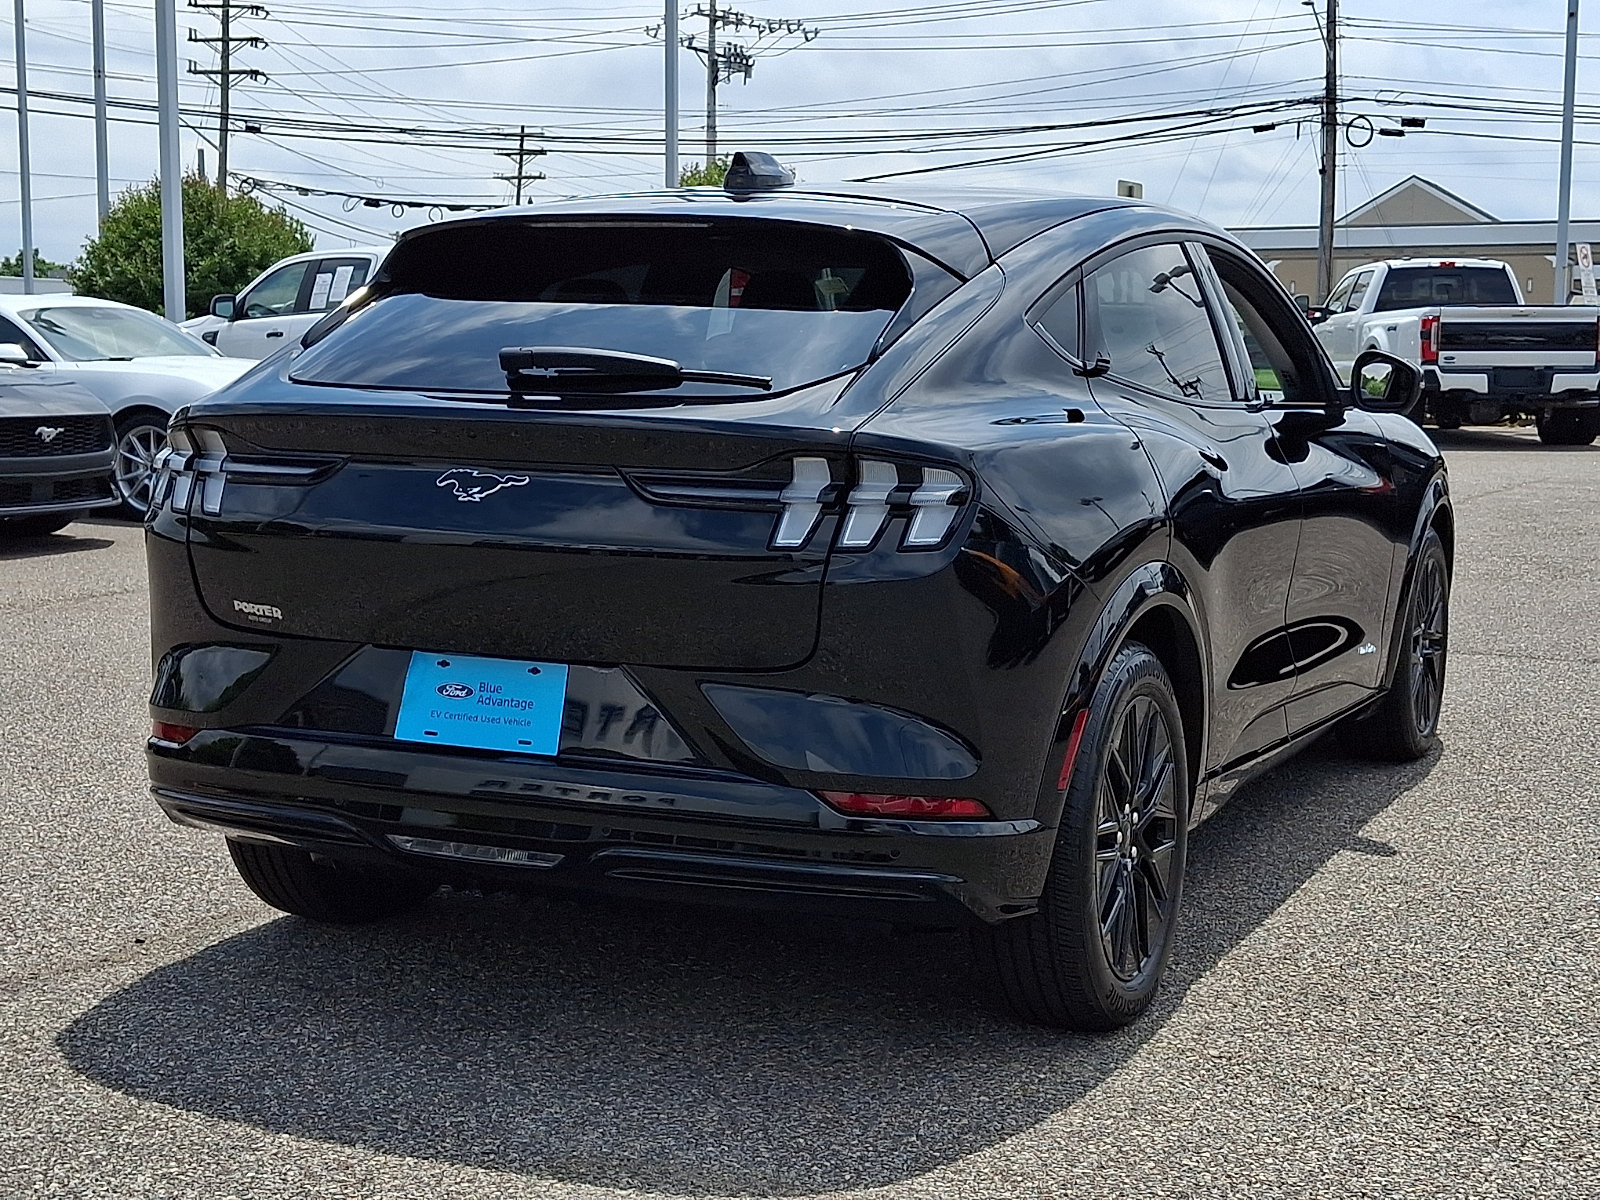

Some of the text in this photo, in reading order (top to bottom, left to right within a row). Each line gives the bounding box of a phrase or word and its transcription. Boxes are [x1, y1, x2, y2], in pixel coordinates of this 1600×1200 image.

[233, 600, 283, 620] PORTER
[442, 684, 469, 698] Ford
[478, 681, 503, 694] Blue
[476, 694, 534, 711] Advantage
[430, 709, 532, 727] EV Certified Used Vehicle
